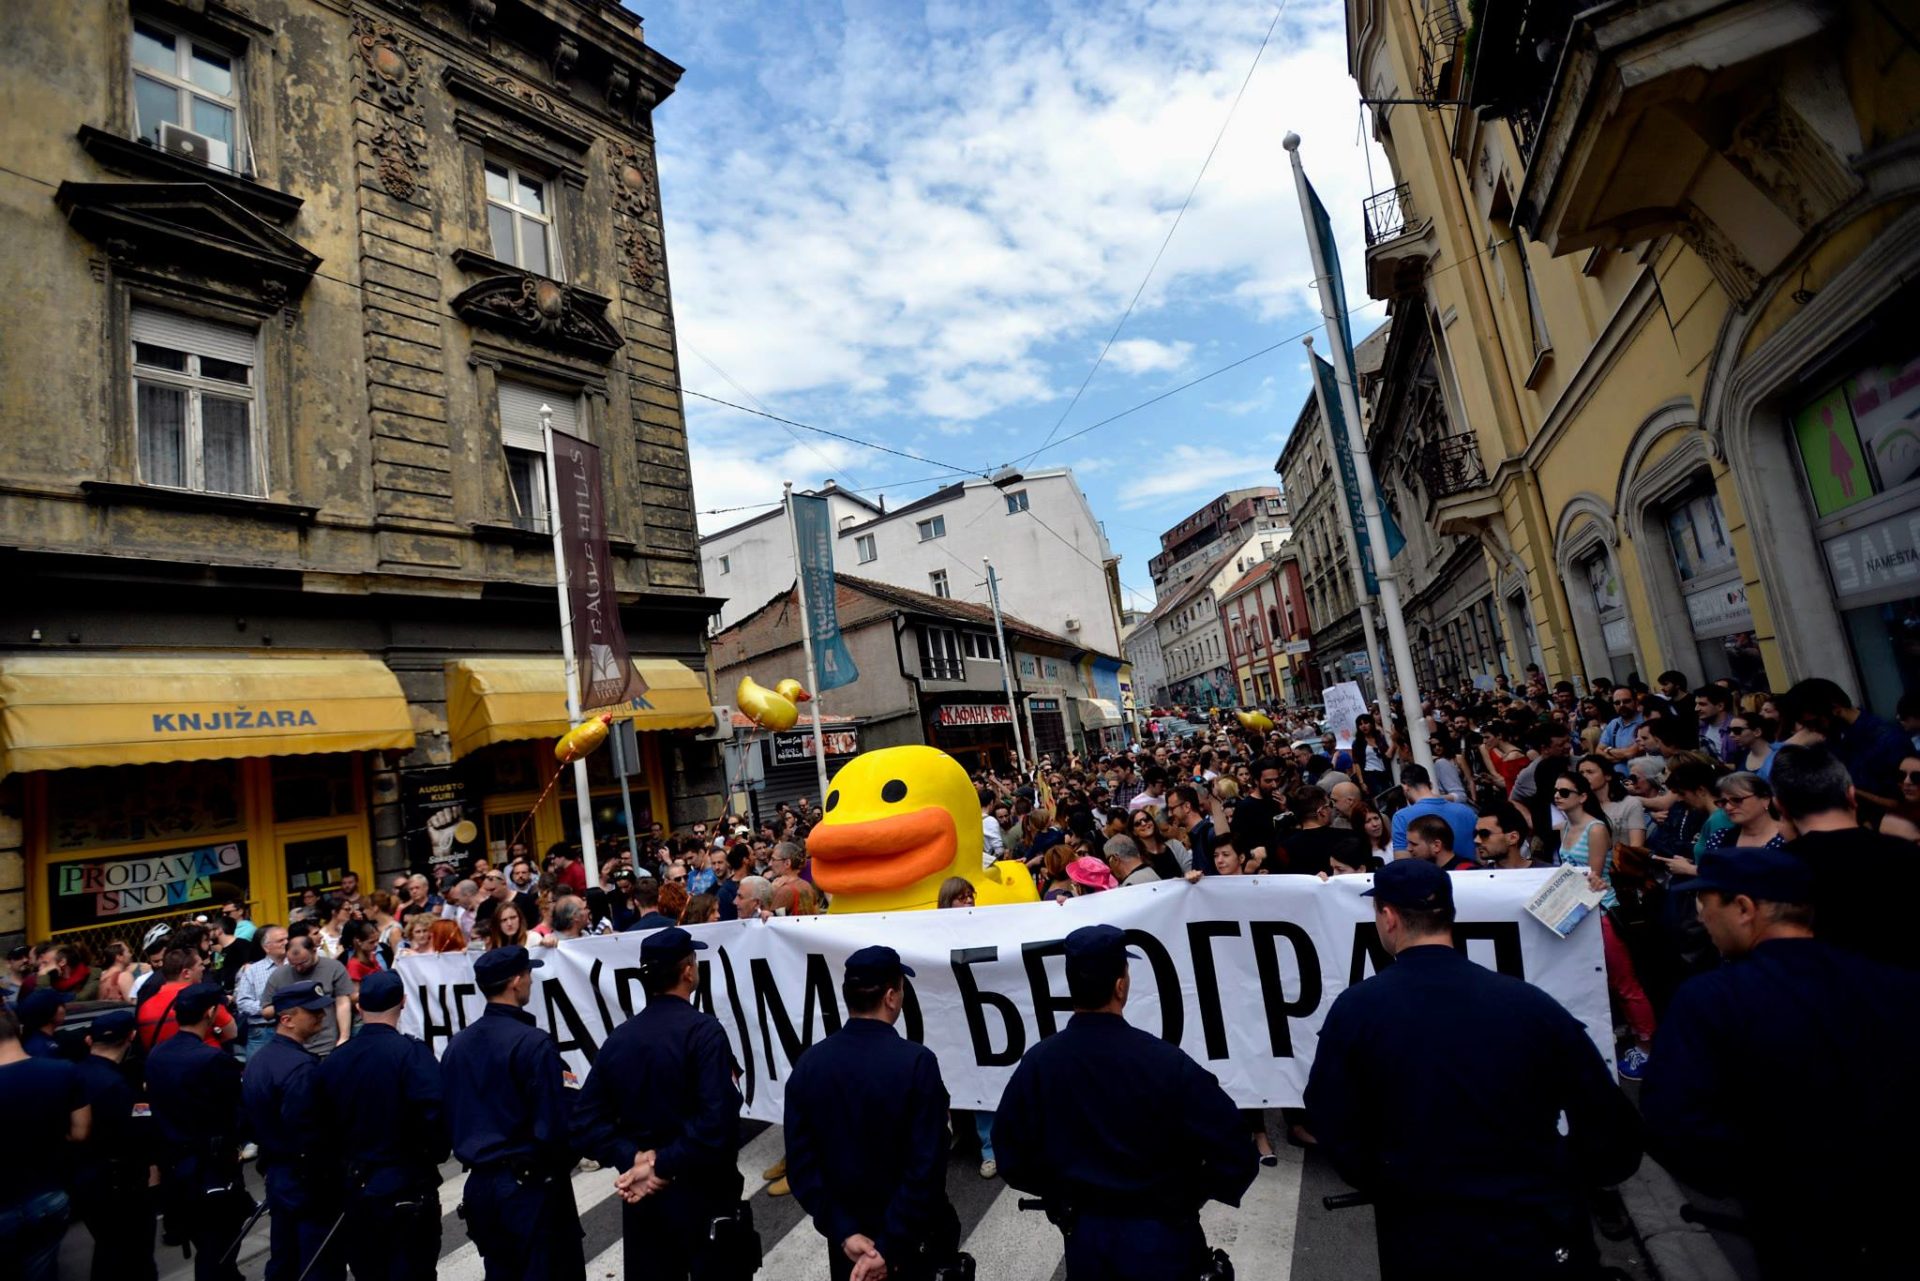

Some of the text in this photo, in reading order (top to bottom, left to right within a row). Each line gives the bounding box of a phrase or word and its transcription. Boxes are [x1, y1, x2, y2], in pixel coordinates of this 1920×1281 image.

[571, 447, 593, 534] HILLS
[152, 705, 317, 732] KNJIŽARA
[944, 705, 990, 724] КАФАНА
[418, 783, 464, 794] AUGUSTO
[431, 792, 454, 801] KURI
[64, 844, 239, 892] PRODAVAC
[102, 877, 210, 911] SNOVA
